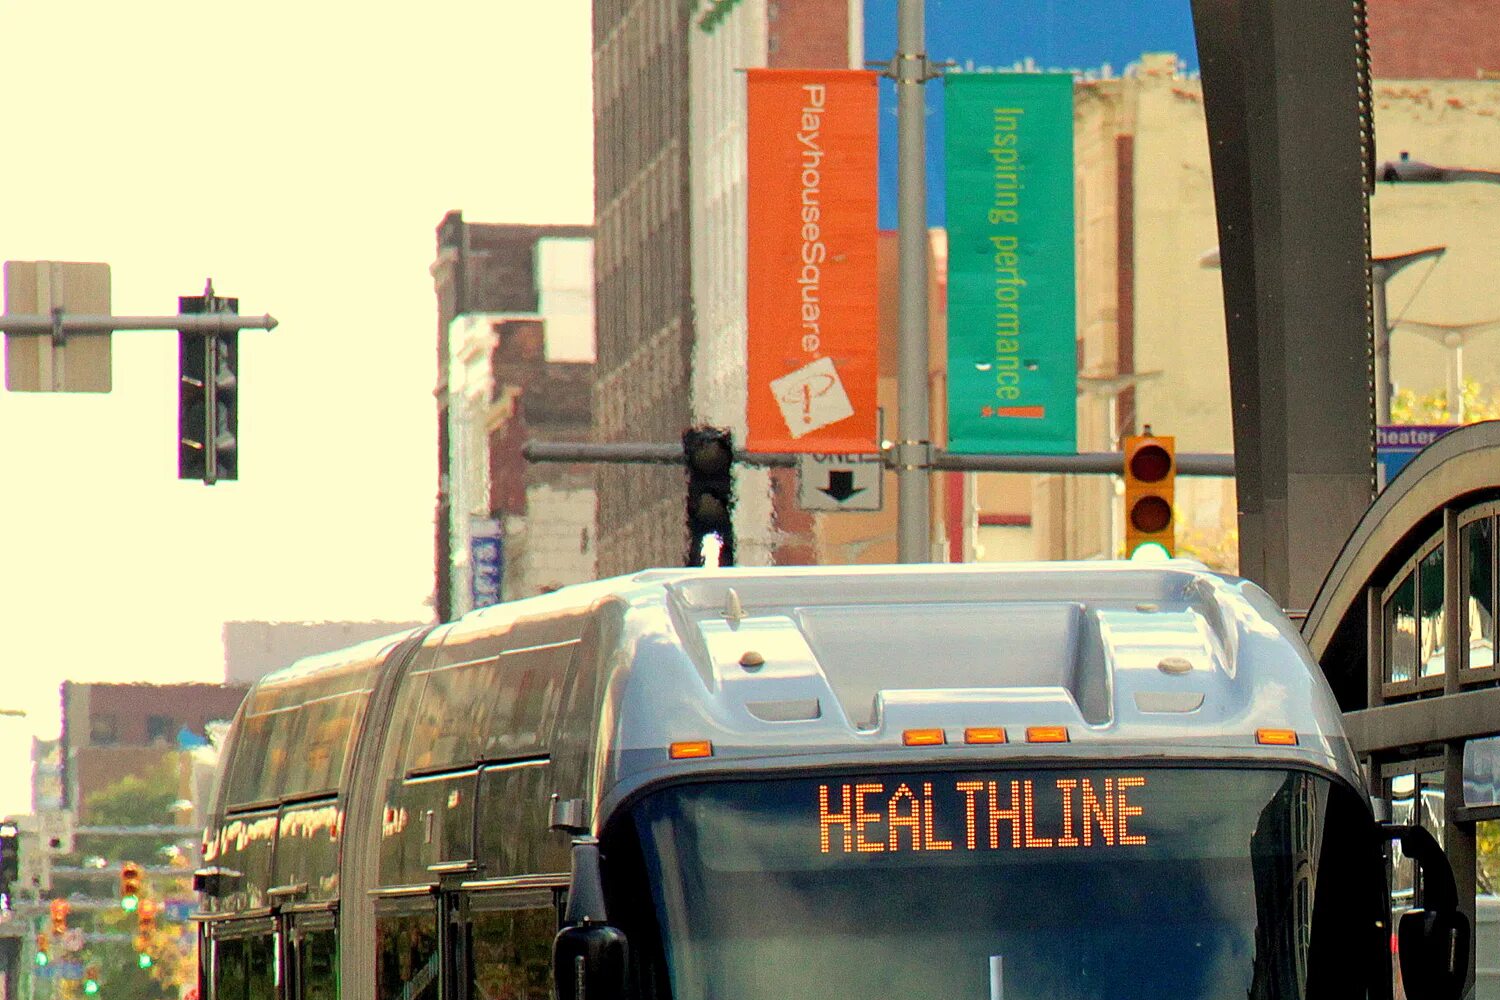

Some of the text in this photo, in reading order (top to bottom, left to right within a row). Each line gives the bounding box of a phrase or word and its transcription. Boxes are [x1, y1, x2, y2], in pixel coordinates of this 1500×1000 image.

[988, 108, 1024, 224] Inspiring
[797, 84, 826, 352] PlayhouseSquare
[1376, 429, 1437, 444] heater
[819, 777, 1147, 853] HEALTHLINE
